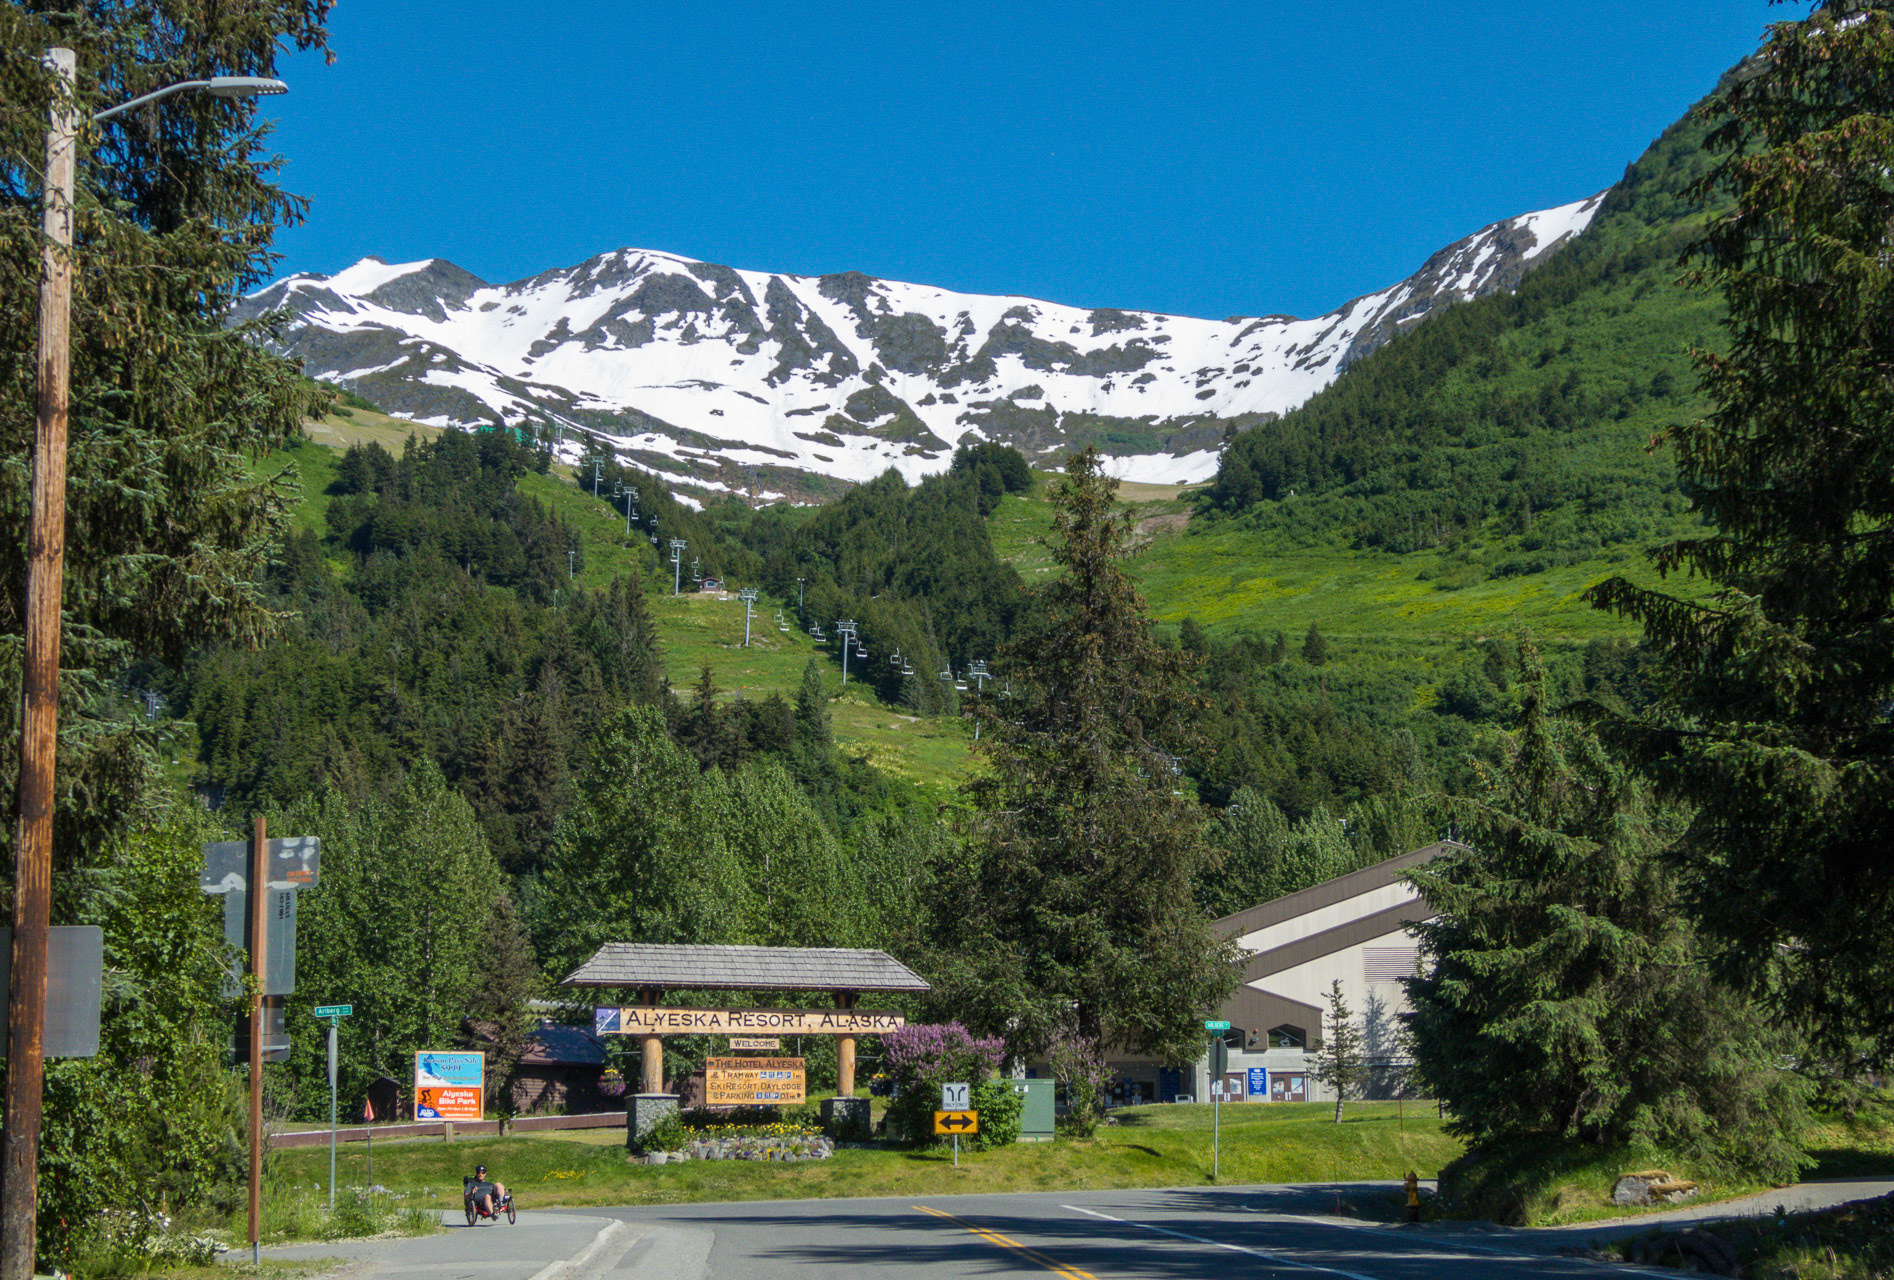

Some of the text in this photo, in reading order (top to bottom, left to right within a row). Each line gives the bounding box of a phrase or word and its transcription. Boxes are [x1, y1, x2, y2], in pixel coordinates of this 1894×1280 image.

[626, 1011, 899, 1028] ALYESKA RESORT, ALASKA
[734, 1040, 776, 1048] WELCOME
[464, 1056, 479, 1064] Sale
[714, 1059, 804, 1068] THE HOTEL ALYESKA
[440, 1064, 461, 1072] $999
[712, 1071, 719, 1079] &
[722, 1070, 759, 1079] TRAMWAY
[442, 1090, 473, 1098] Alyeska
[720, 1092, 755, 1100] PARKING
